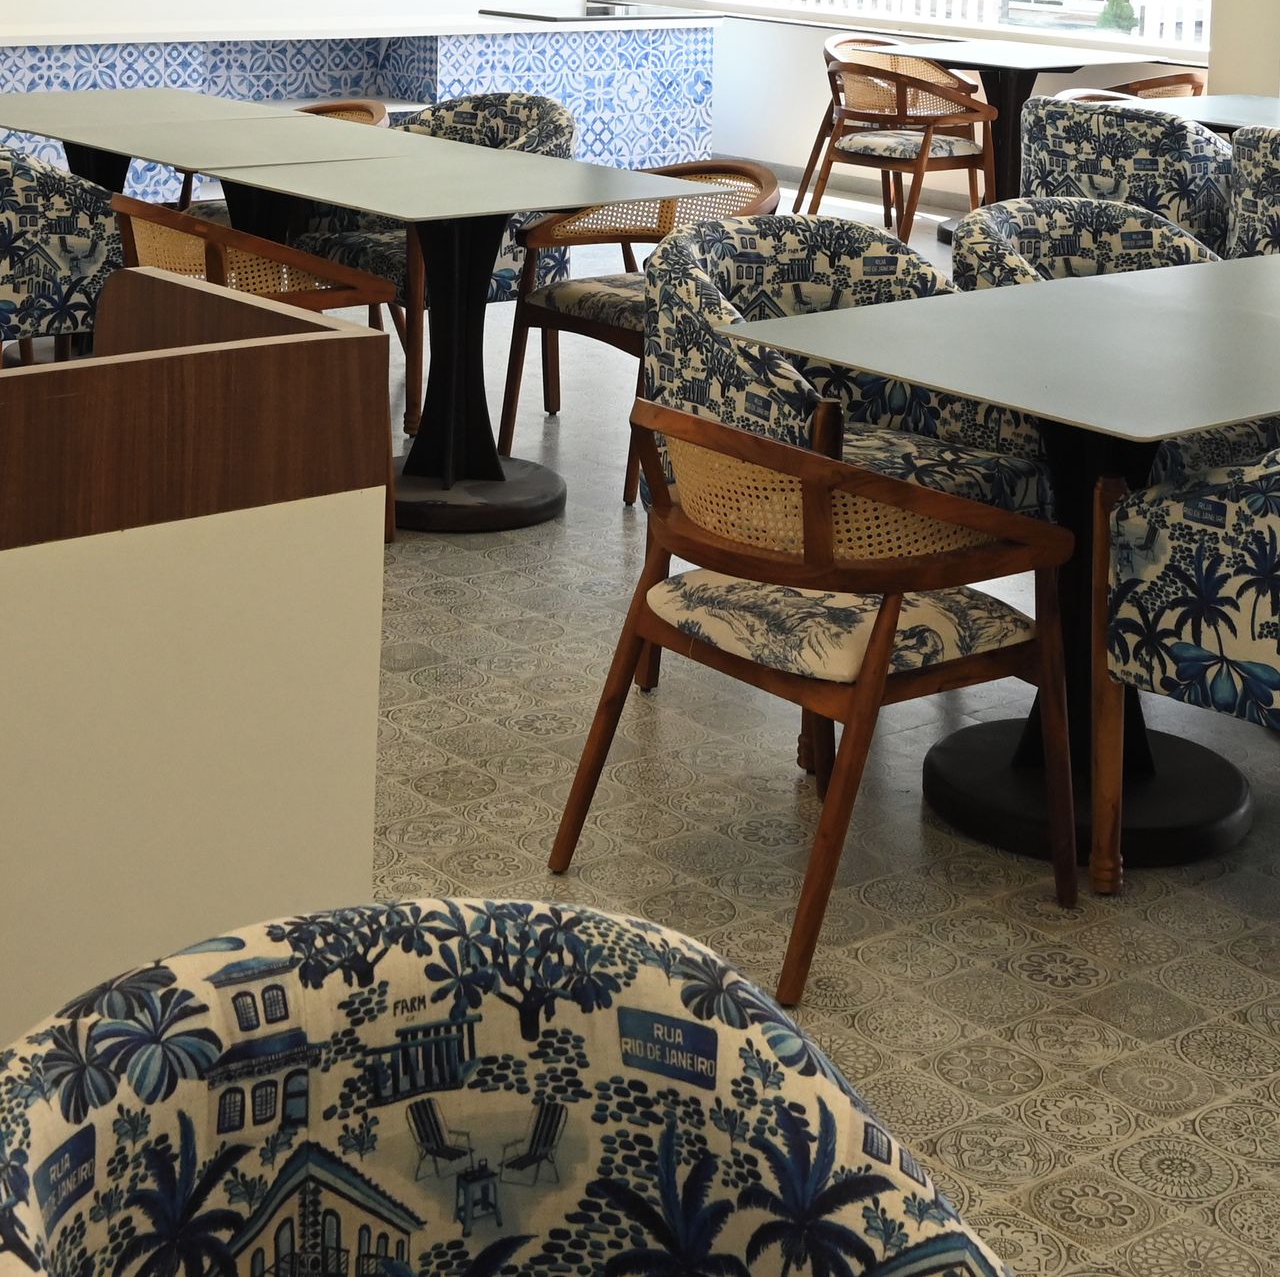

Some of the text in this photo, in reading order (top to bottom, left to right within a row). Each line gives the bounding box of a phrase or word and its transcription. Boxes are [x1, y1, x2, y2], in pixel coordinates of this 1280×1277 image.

[393, 994, 427, 1017] FARM
[652, 1023, 684, 1045] RUA
[622, 1037, 716, 1078] RIO DE JANEIRO
[49, 1153, 71, 1184] RUA
[57, 1158, 96, 1205] JANEIRO
